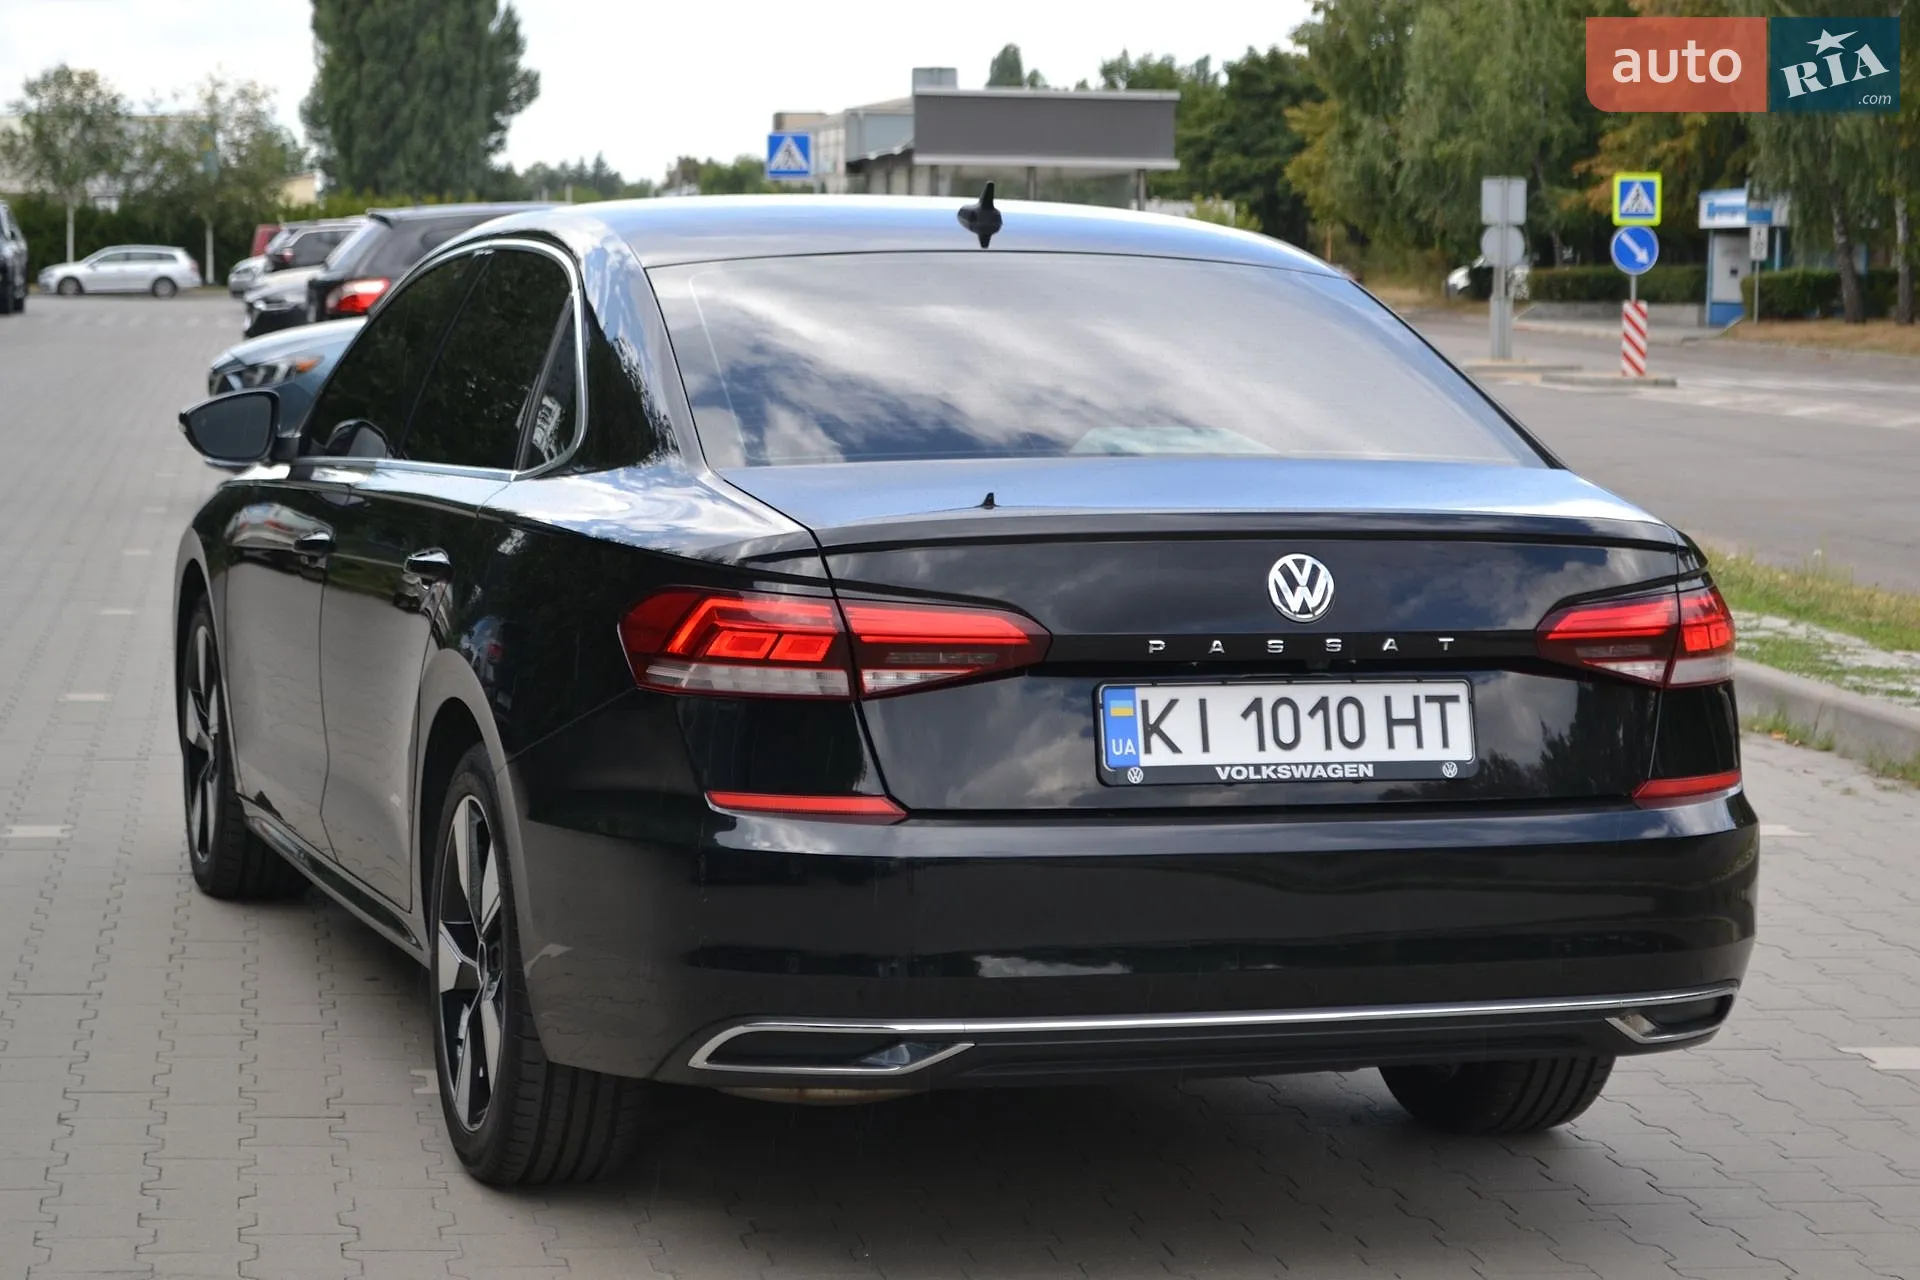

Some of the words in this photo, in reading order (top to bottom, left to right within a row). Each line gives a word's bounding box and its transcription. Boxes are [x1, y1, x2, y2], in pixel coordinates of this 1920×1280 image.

[1268, 553, 1335, 623] VW
[1148, 637, 1455, 654] PASSAT
[1141, 697, 1211, 755] KI
[1240, 695, 1366, 752] 1010
[1384, 694, 1461, 750] HT
[1111, 738, 1136, 756] UA
[1215, 762, 1375, 781] VOLKSWAGEN
